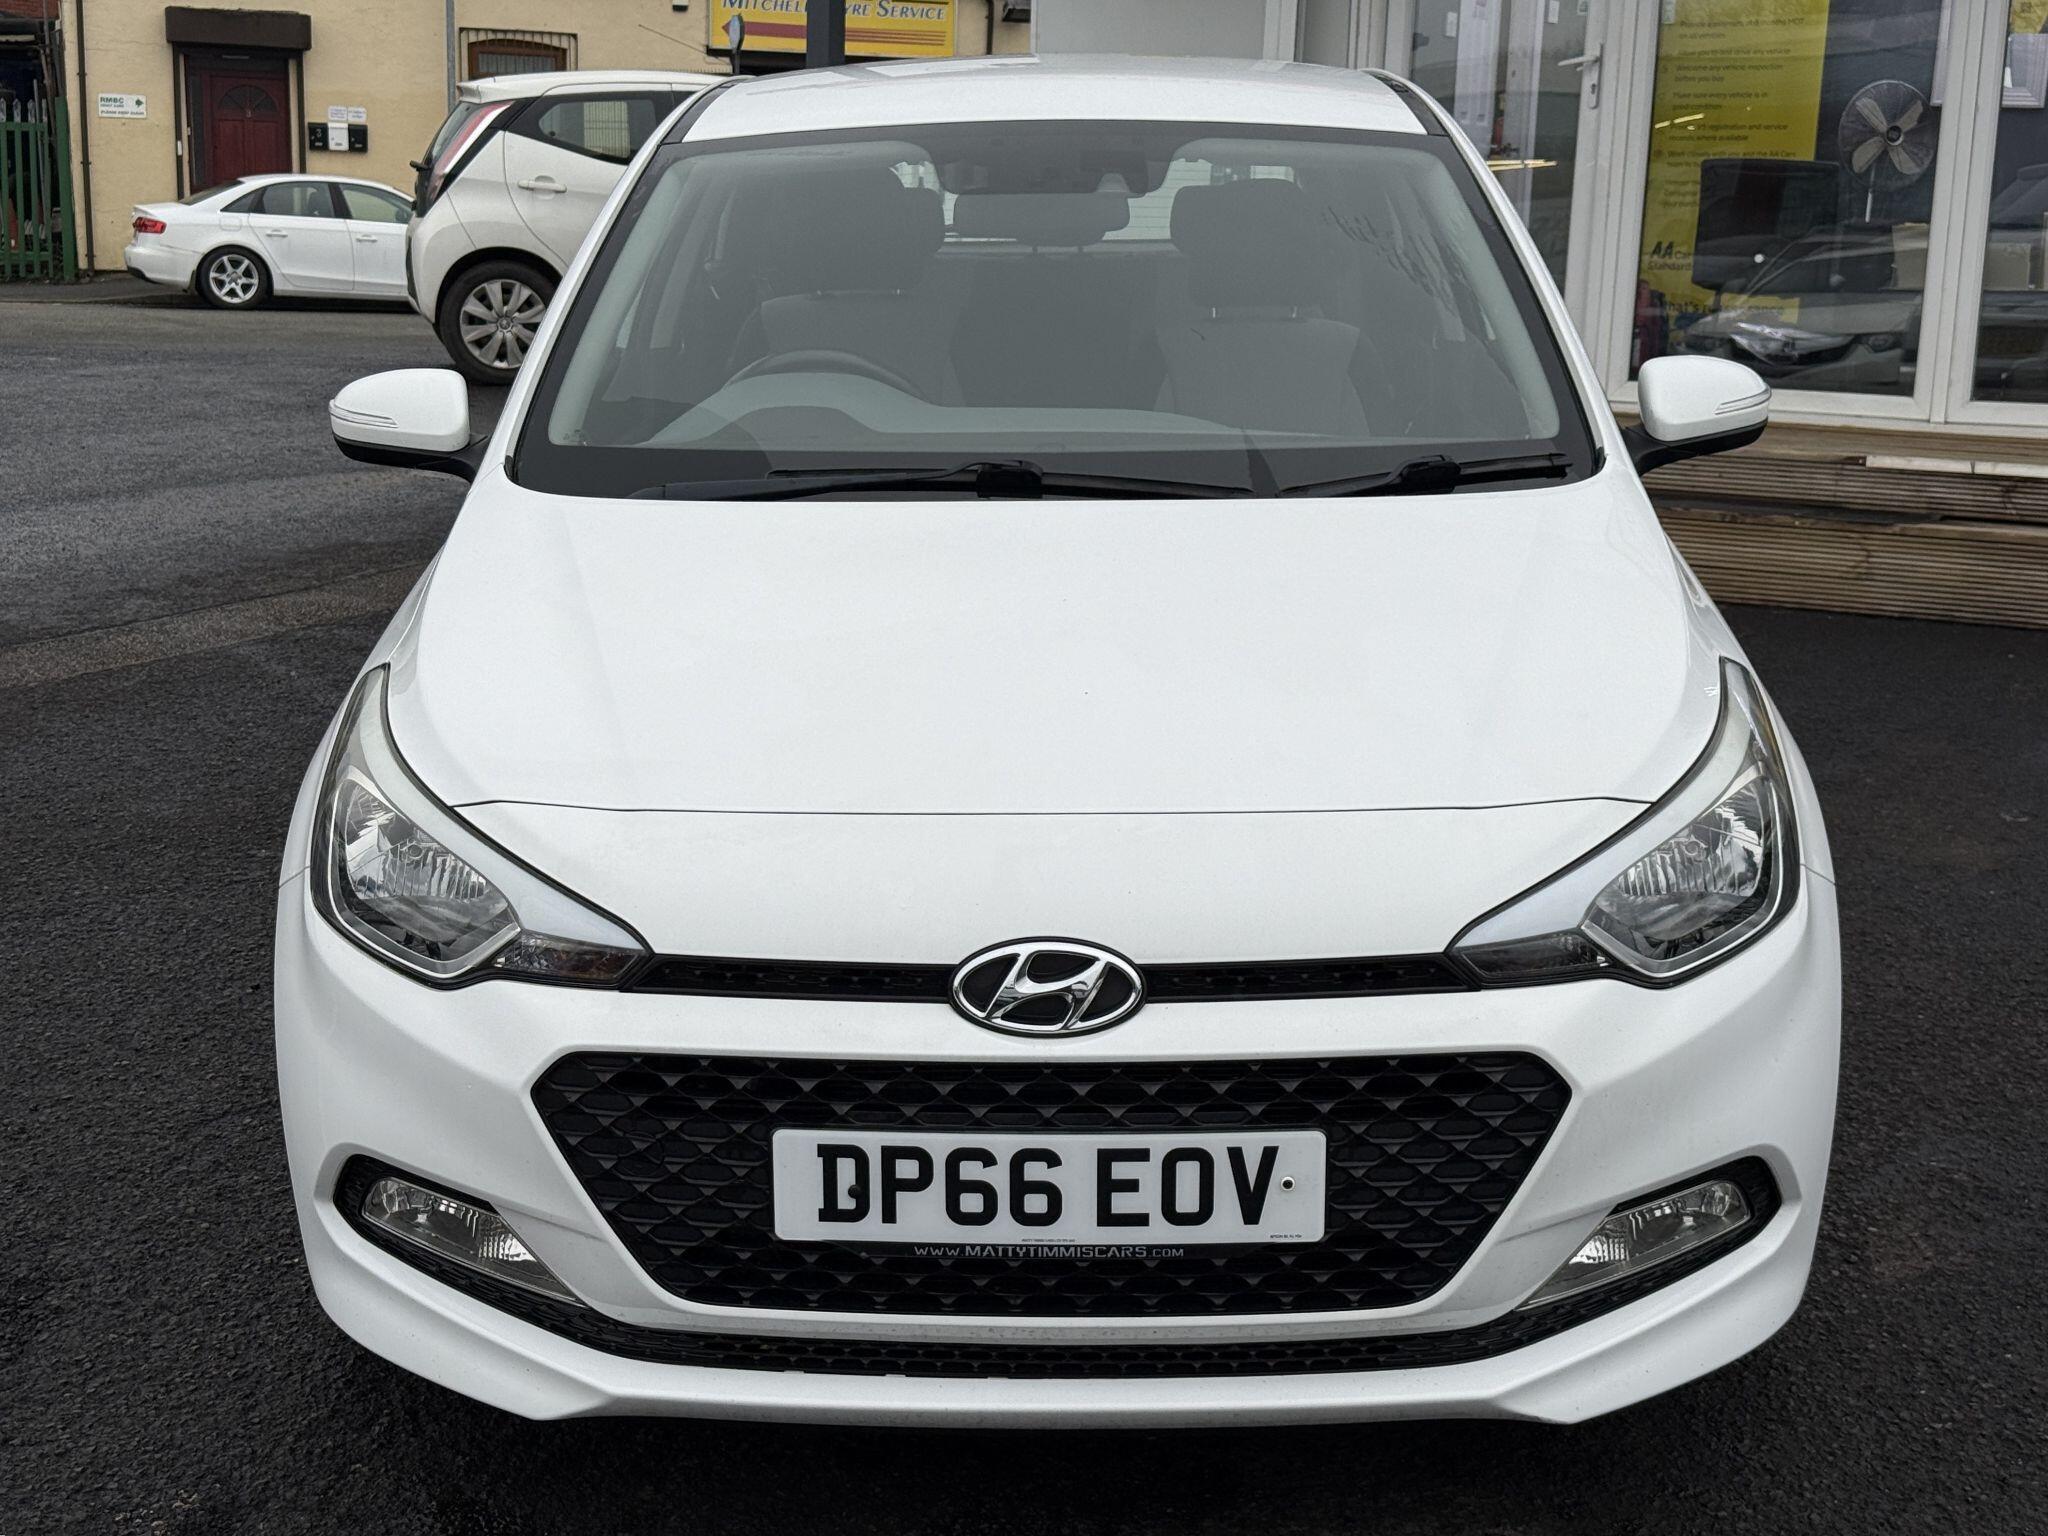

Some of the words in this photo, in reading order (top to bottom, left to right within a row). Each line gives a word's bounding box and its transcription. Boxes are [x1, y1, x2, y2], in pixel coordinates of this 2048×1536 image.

[722, 0, 808, 12] MITCHEL
[876, 0, 945, 20] SERVICE
[99, 96, 124, 104] RMBC
[1650, 240, 1674, 258] AA
[1647, 260, 1693, 271] Standard
[817, 1143, 1063, 1227] DP66
[1096, 1145, 1280, 1227] EOV
